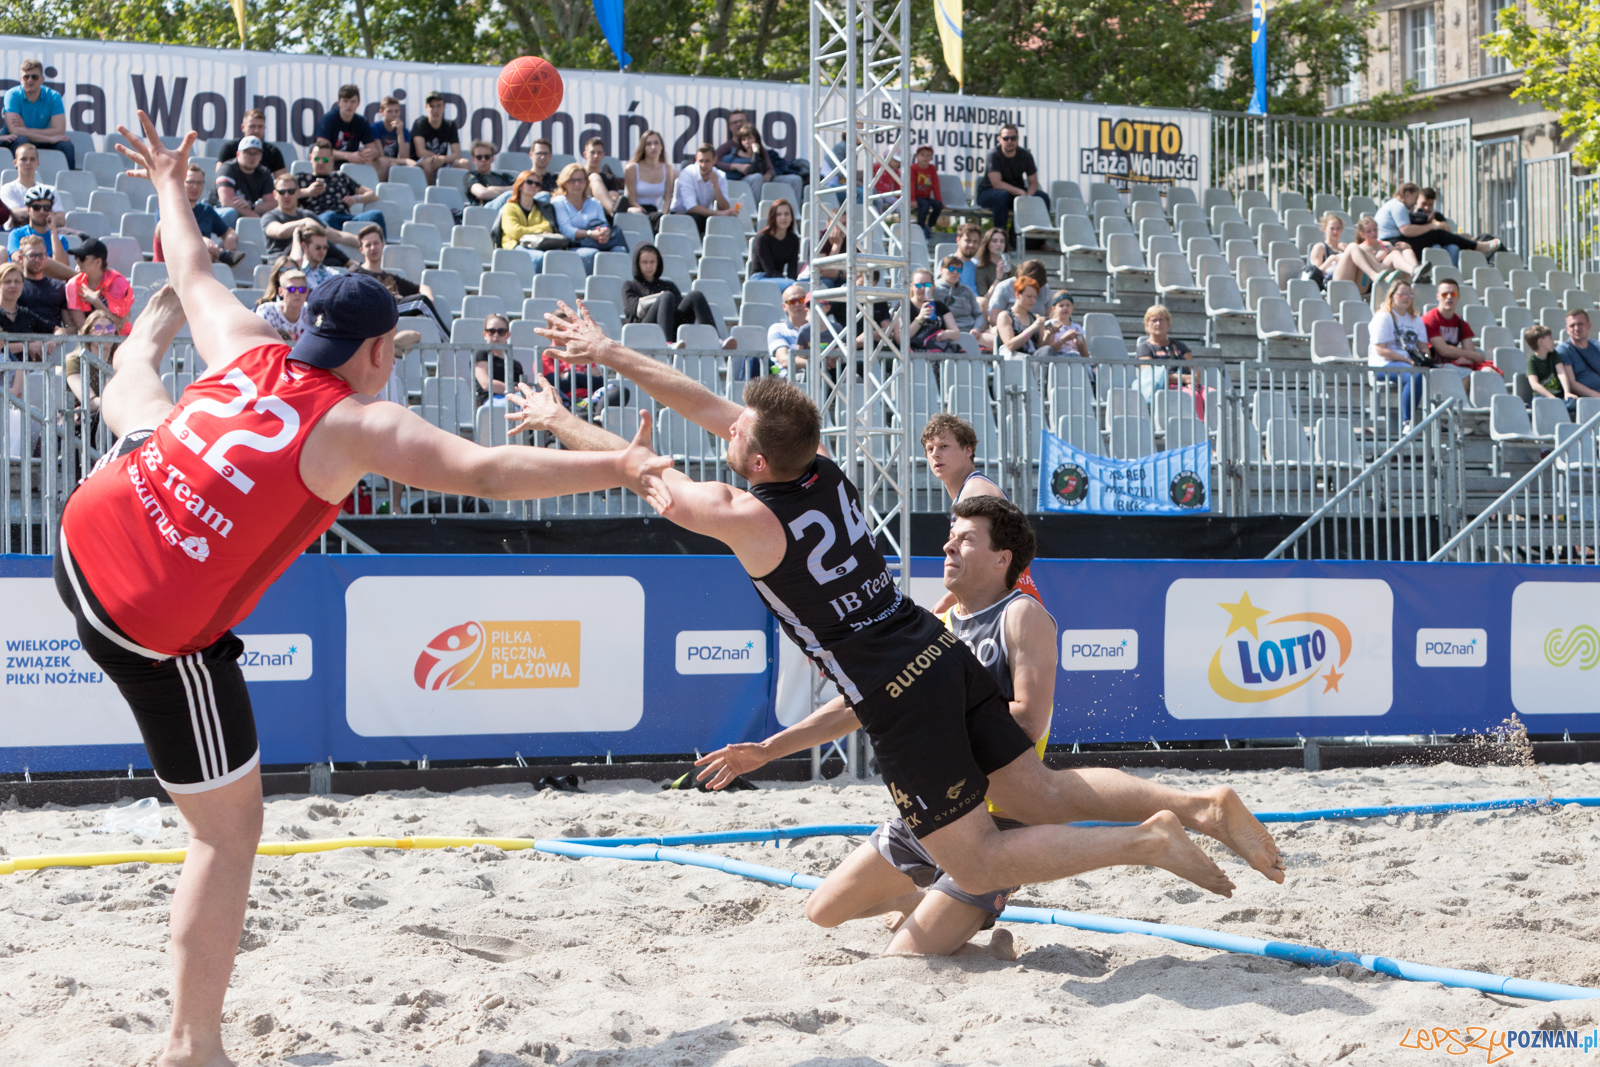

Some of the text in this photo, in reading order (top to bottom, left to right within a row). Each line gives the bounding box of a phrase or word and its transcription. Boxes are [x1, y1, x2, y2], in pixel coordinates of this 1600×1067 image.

[881, 102, 1025, 128] BECH HANDBALL
[1099, 119, 1181, 155] LOTTO
[1081, 149, 1129, 174] Plaża
[1129, 152, 1198, 178] Wolności
[168, 367, 301, 495] 22
[1126, 468, 1146, 481] RED
[162, 464, 234, 538] Team
[1117, 499, 1143, 512] BUK
[788, 479, 877, 586] 24
[828, 590, 863, 622] JB
[491, 630, 532, 644] PIŁKA
[6, 656, 71, 670] ZWIĄZEK
[239, 651, 293, 666] OZnan
[491, 647, 546, 662] RĘCZNA
[1237, 629, 1326, 684] LOTTO
[6, 669, 104, 685] PIŁKI NOŻNEJ
[491, 660, 572, 679] PLAŻOWA
